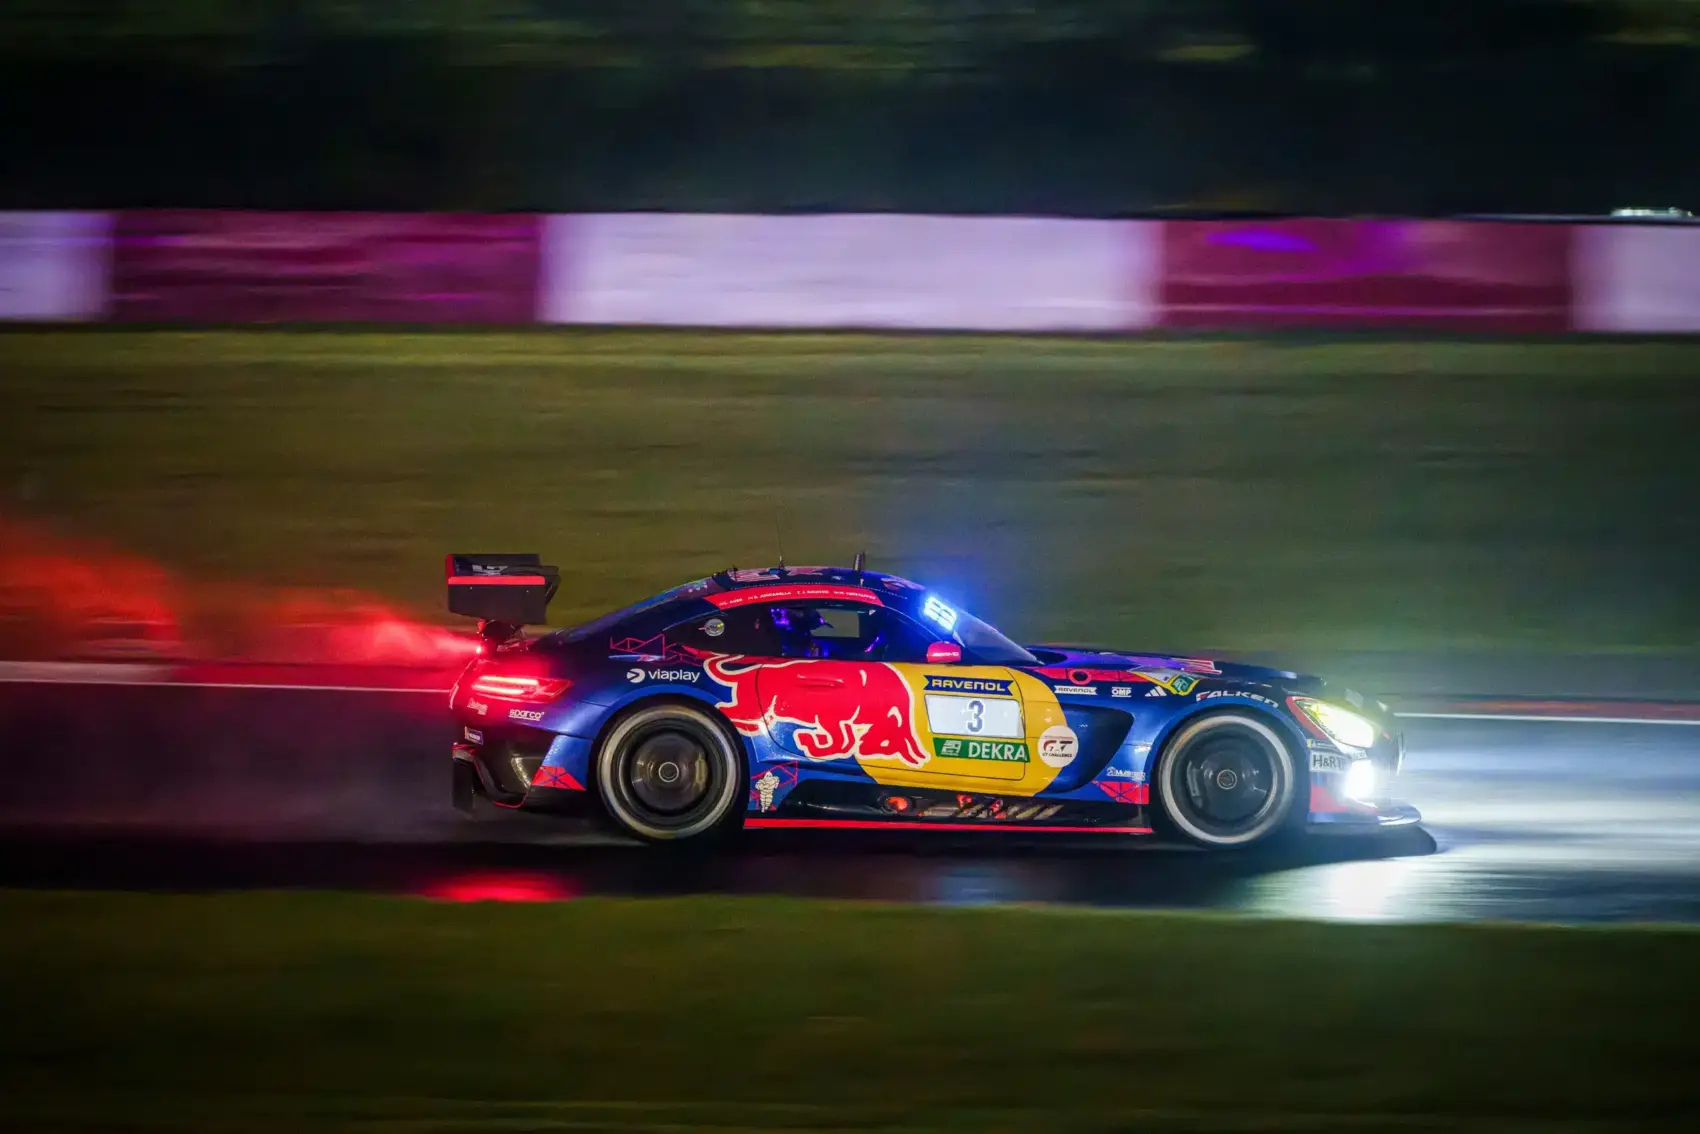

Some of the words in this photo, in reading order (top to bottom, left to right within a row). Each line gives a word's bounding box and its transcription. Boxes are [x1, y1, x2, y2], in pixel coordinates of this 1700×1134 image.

[648, 669, 701, 683] viaplay
[931, 679, 1006, 692] RAVENOL
[1112, 688, 1132, 696] OMP
[1196, 690, 1279, 708] FALKEN
[967, 700, 984, 733] 3
[968, 742, 1028, 761] DEKRA
